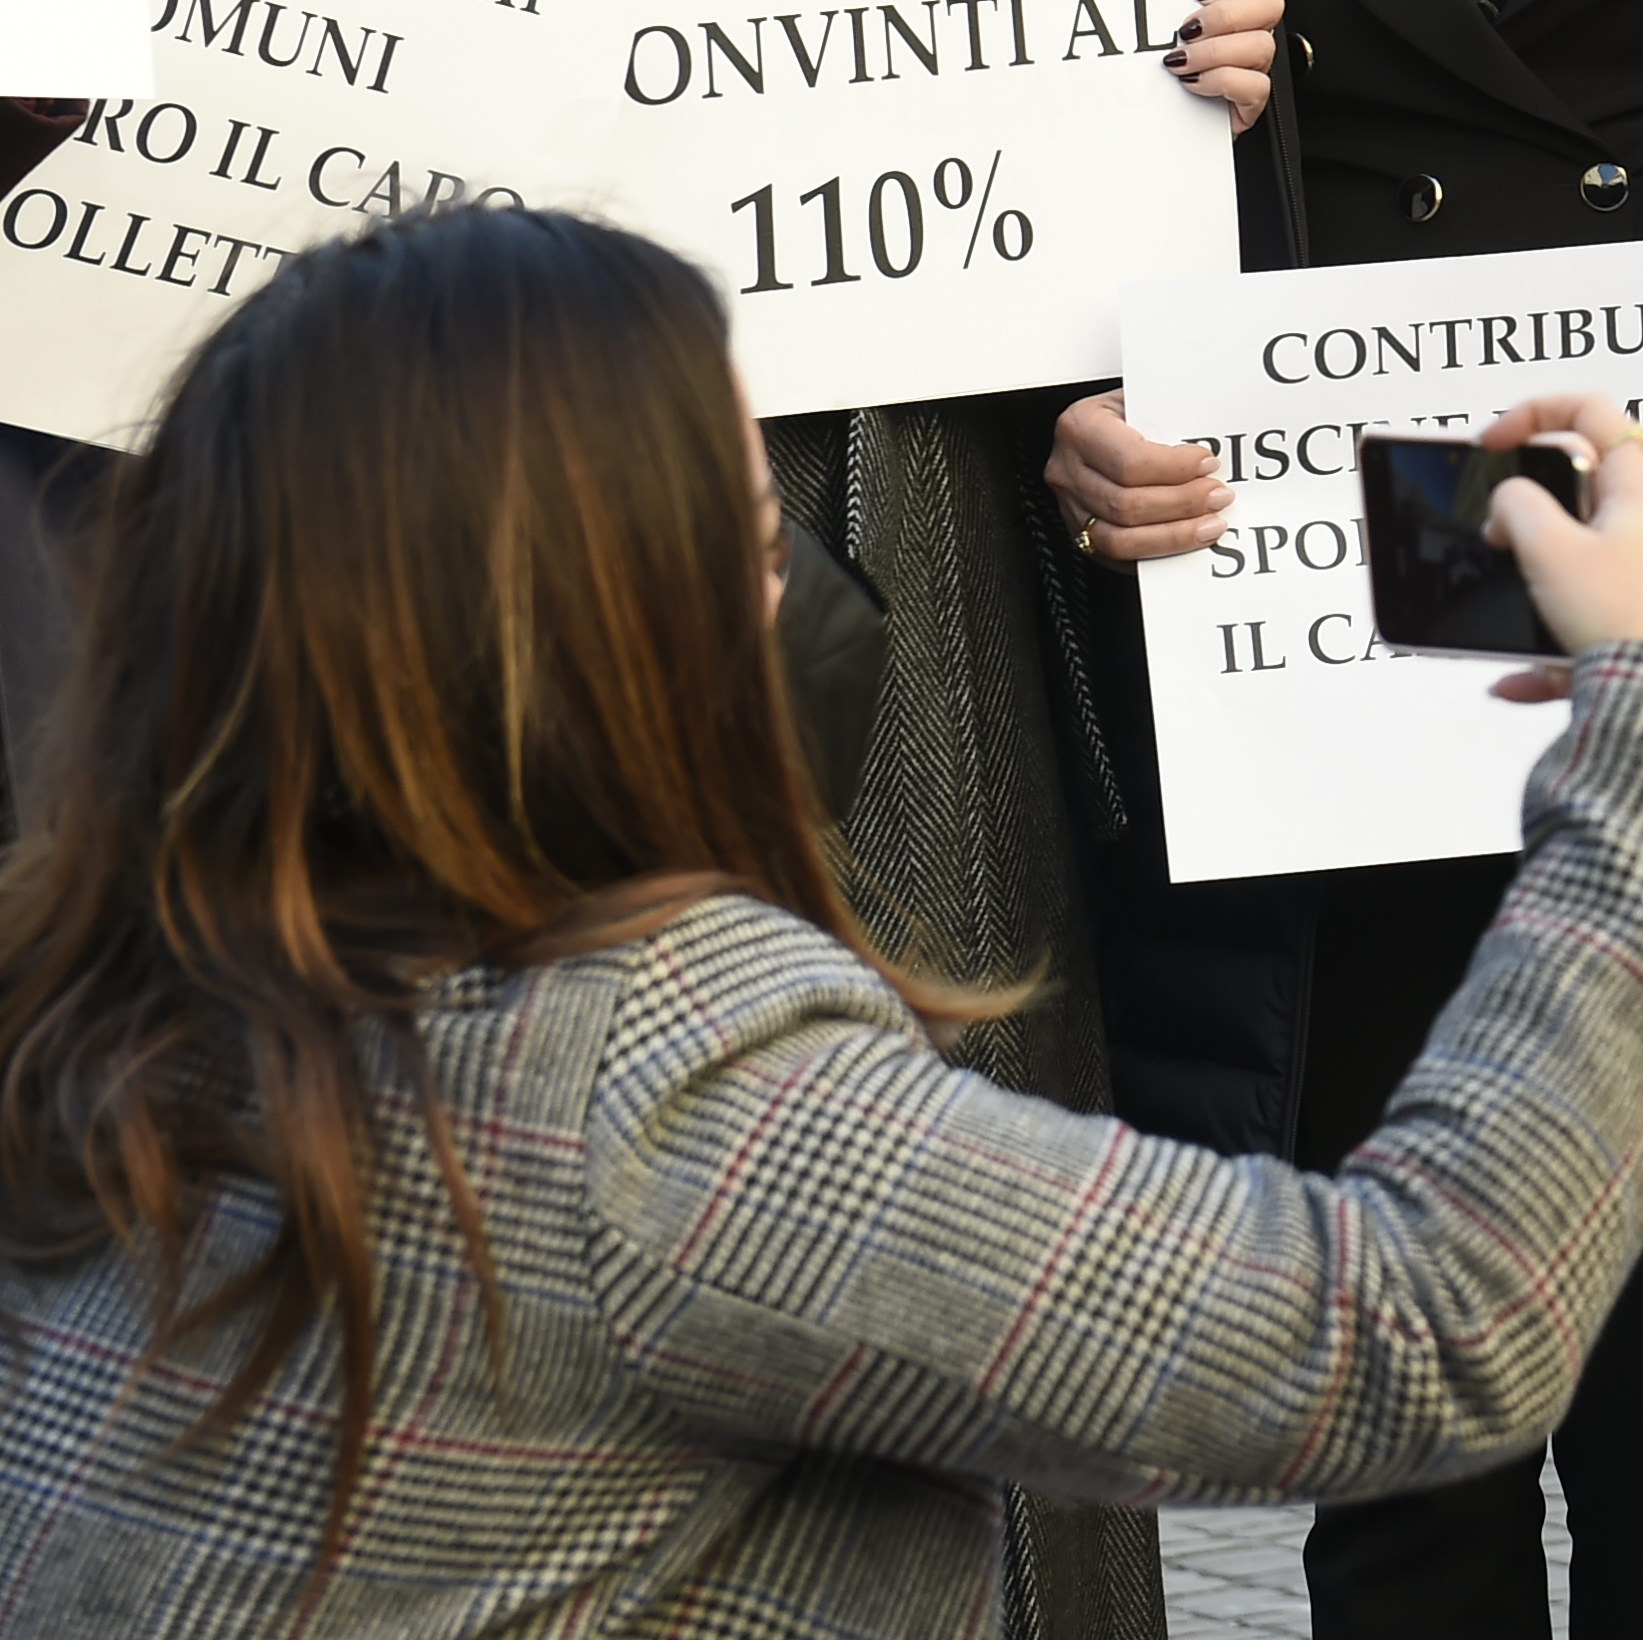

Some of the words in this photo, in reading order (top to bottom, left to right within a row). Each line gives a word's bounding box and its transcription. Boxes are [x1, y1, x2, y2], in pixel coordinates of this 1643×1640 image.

[74, 99, 198, 163] RO
[209, 119, 282, 191] IL
[730, 149, 1034, 295] 110%
[1216, 620, 1286, 675] IL
